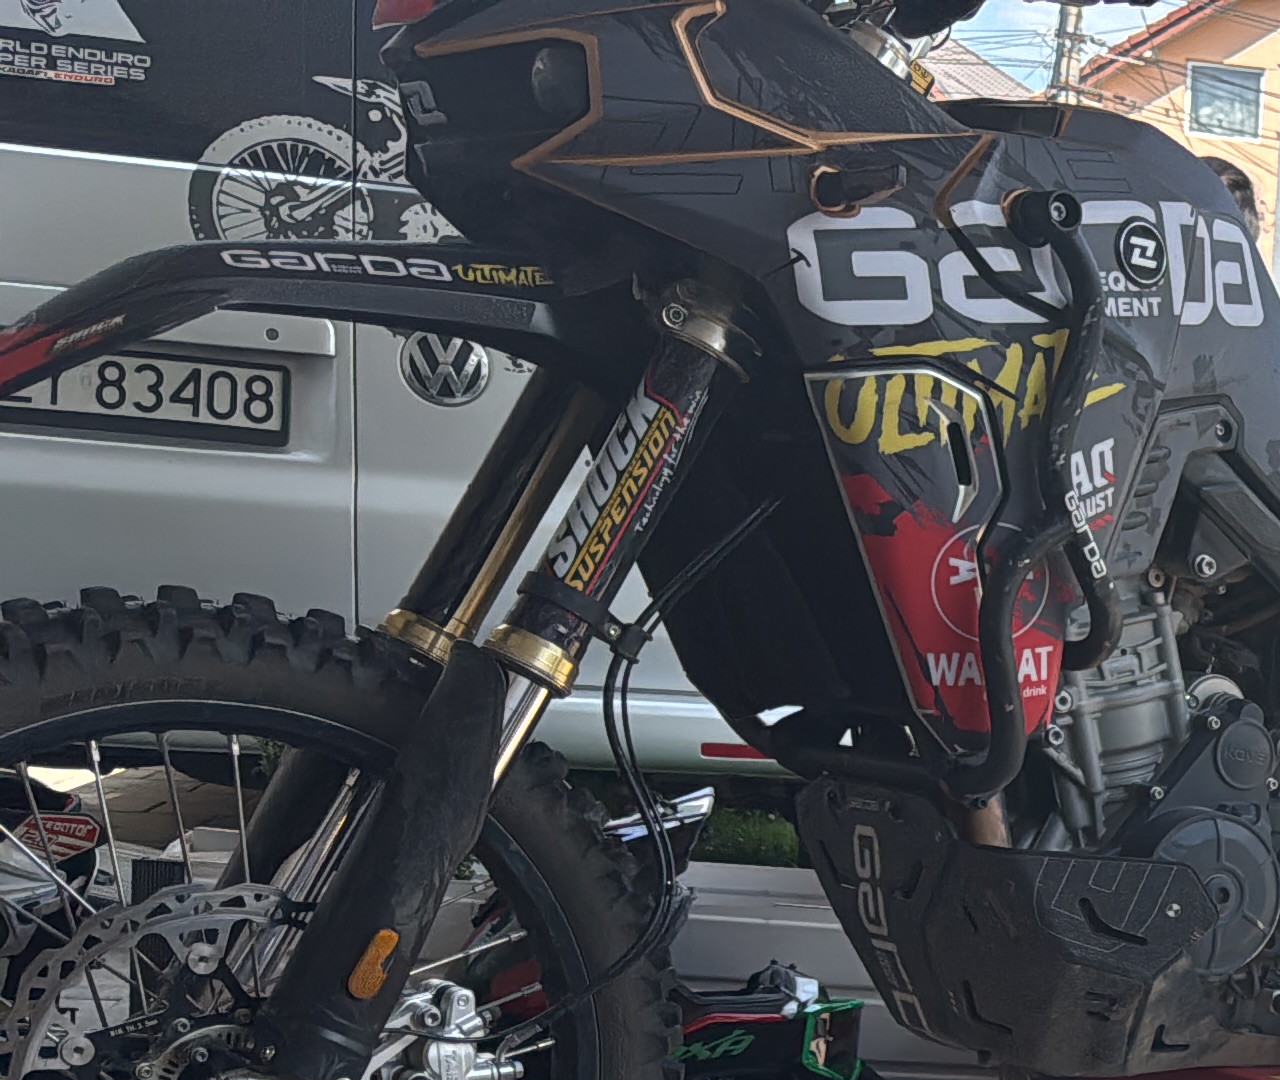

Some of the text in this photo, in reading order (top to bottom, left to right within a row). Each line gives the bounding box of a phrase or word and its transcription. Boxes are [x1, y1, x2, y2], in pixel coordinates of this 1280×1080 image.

[0, 39, 152, 68] RLD ENDURO
[0, 53, 147, 81] PER SERIES
[452, 263, 555, 288] ULTIMATE
[95, 360, 274, 424] 83408
[549, 376, 662, 579] SHOCK
[564, 408, 676, 592] SUSPENSION
[634, 466, 676, 533] Technology
[926, 646, 1054, 687] WAAT
[1022, 684, 1048, 698] drink
